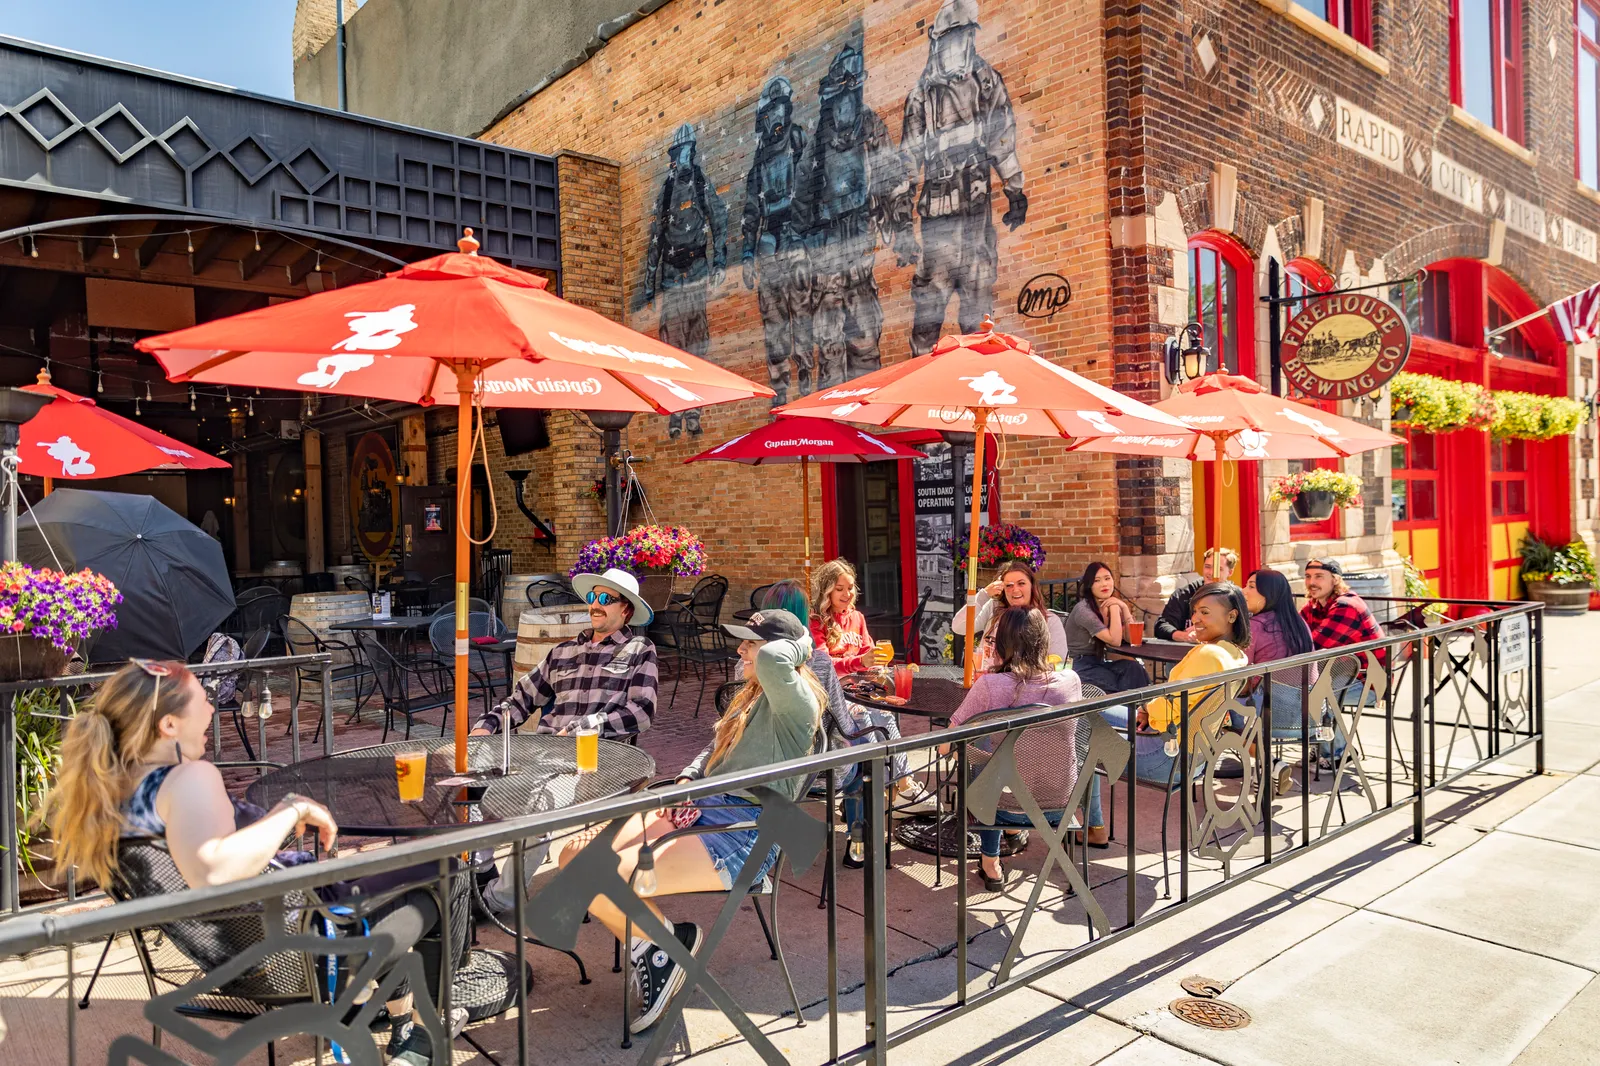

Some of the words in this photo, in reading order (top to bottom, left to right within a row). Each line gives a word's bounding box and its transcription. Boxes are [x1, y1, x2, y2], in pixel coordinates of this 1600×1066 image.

[1340, 105, 1400, 162] RAPID
[1439, 161, 1479, 205] CITY
[1510, 197, 1541, 240] FIRE
[1566, 225, 1594, 257] DEPT
[1284, 296, 1400, 347] FIREHOUSE
[1285, 357, 1375, 397] BREWING
[1376, 343, 1403, 373] CO.
[764, 439, 797, 448] Captain
[797, 438, 834, 447] Morgan
[917, 487, 937, 497] SOUTH
[937, 486, 955, 496] DAKO
[917, 497, 955, 508] OPERATING
